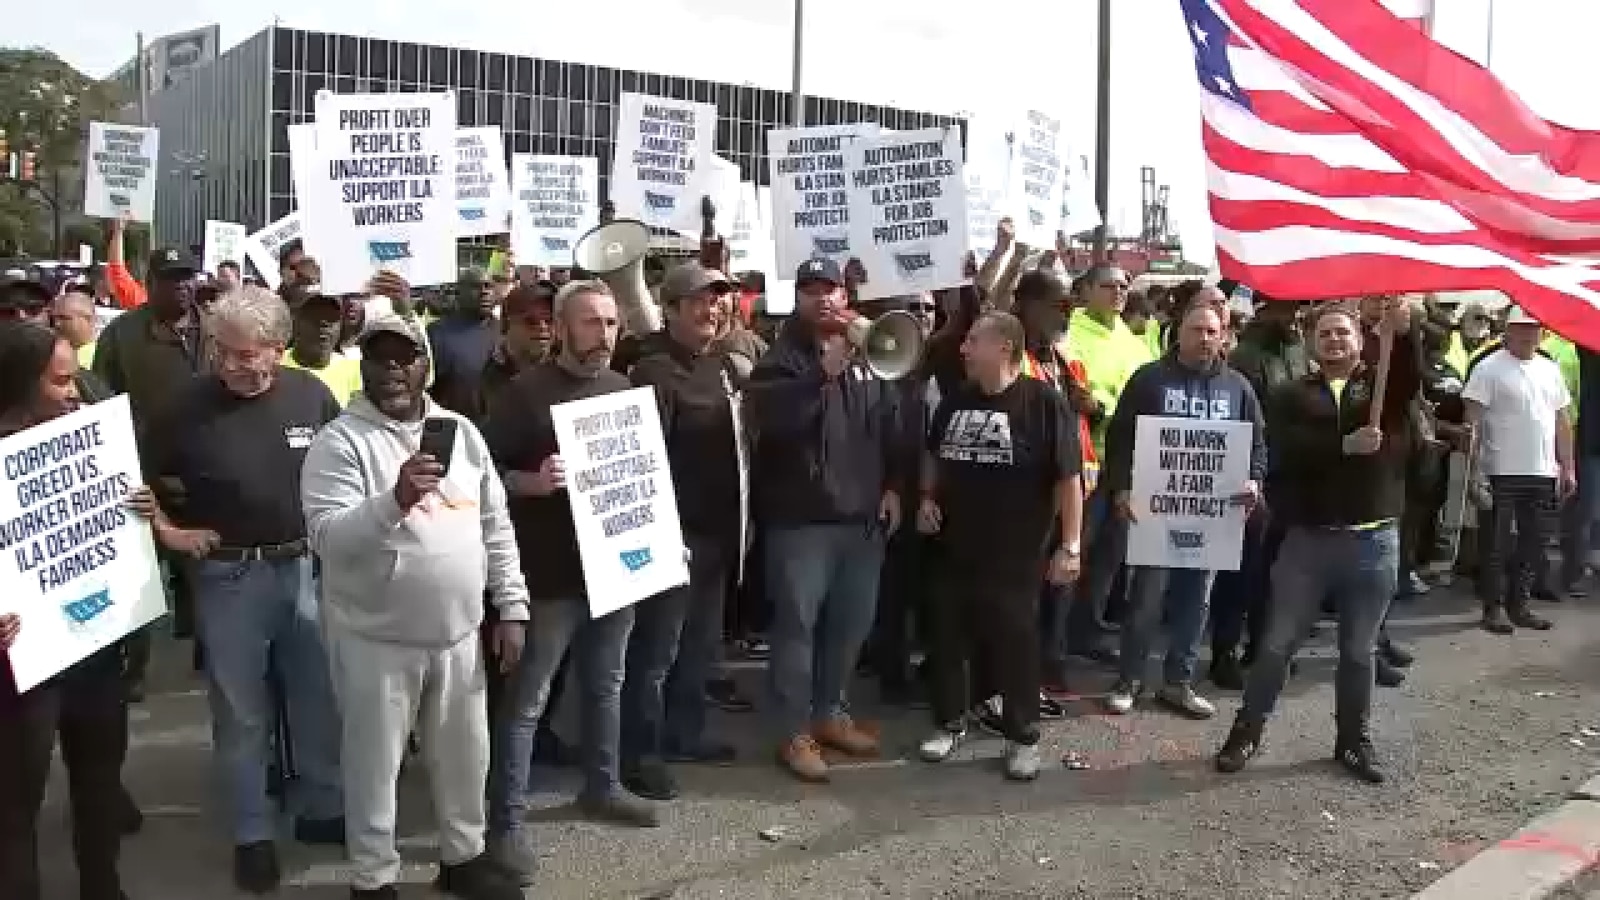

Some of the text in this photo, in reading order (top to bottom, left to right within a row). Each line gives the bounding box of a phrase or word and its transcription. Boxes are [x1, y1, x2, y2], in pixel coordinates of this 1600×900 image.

[339, 107, 431, 130] PROFIT OVER
[351, 131, 422, 154] PEOPLE IS
[864, 140, 944, 166] AUTOMATION
[814, 172, 847, 190] STAN
[852, 166, 896, 188] HURTS
[342, 179, 433, 203] SUPPORT ILA
[804, 191, 829, 209] FOR
[872, 179, 943, 205] ILA STANDS
[353, 202, 424, 225] WORKERS
[794, 208, 850, 228] PROTECTI
[884, 200, 934, 223] FOR JOB
[872, 219, 949, 246] PROTECTION
[4, 420, 104, 480] CORPORATE
[1159, 426, 1228, 451] NO WORK
[1159, 449, 1226, 473] WITHOUT
[17, 464, 74, 508] GREED
[1166, 472, 1214, 495] A FAIR
[1150, 494, 1227, 518] CONTRACT
[602, 501, 655, 538] WORKERS
[15, 502, 126, 573] ILA DEMANDS
[38, 536, 118, 594] FAIRNESS
